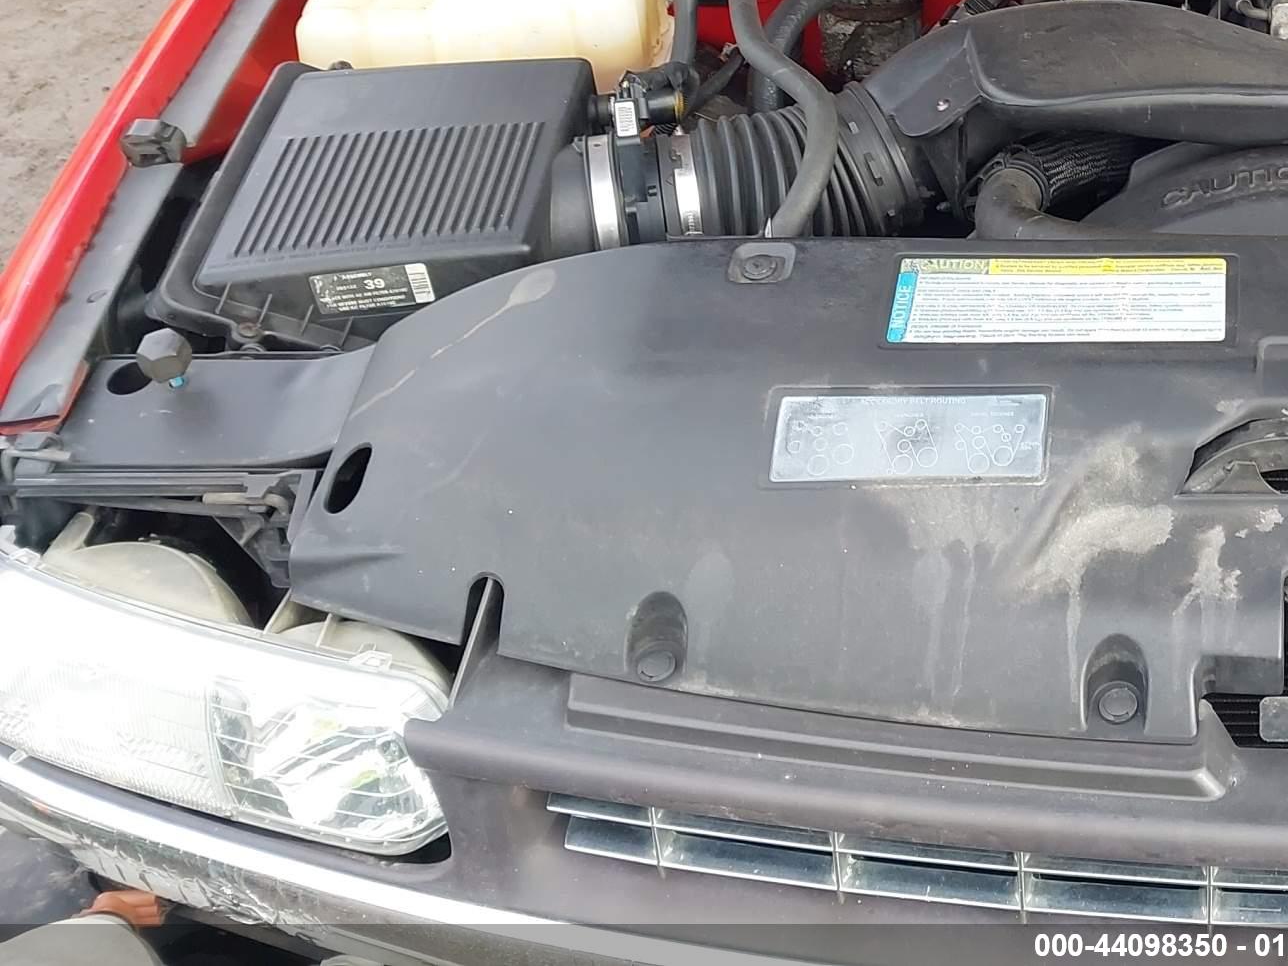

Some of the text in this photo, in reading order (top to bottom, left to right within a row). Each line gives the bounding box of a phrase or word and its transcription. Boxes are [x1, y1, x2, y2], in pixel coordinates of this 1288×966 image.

[918, 259, 989, 274] CAUTION
[363, 278, 385, 289] 39
[891, 284, 913, 330] NOTICE
